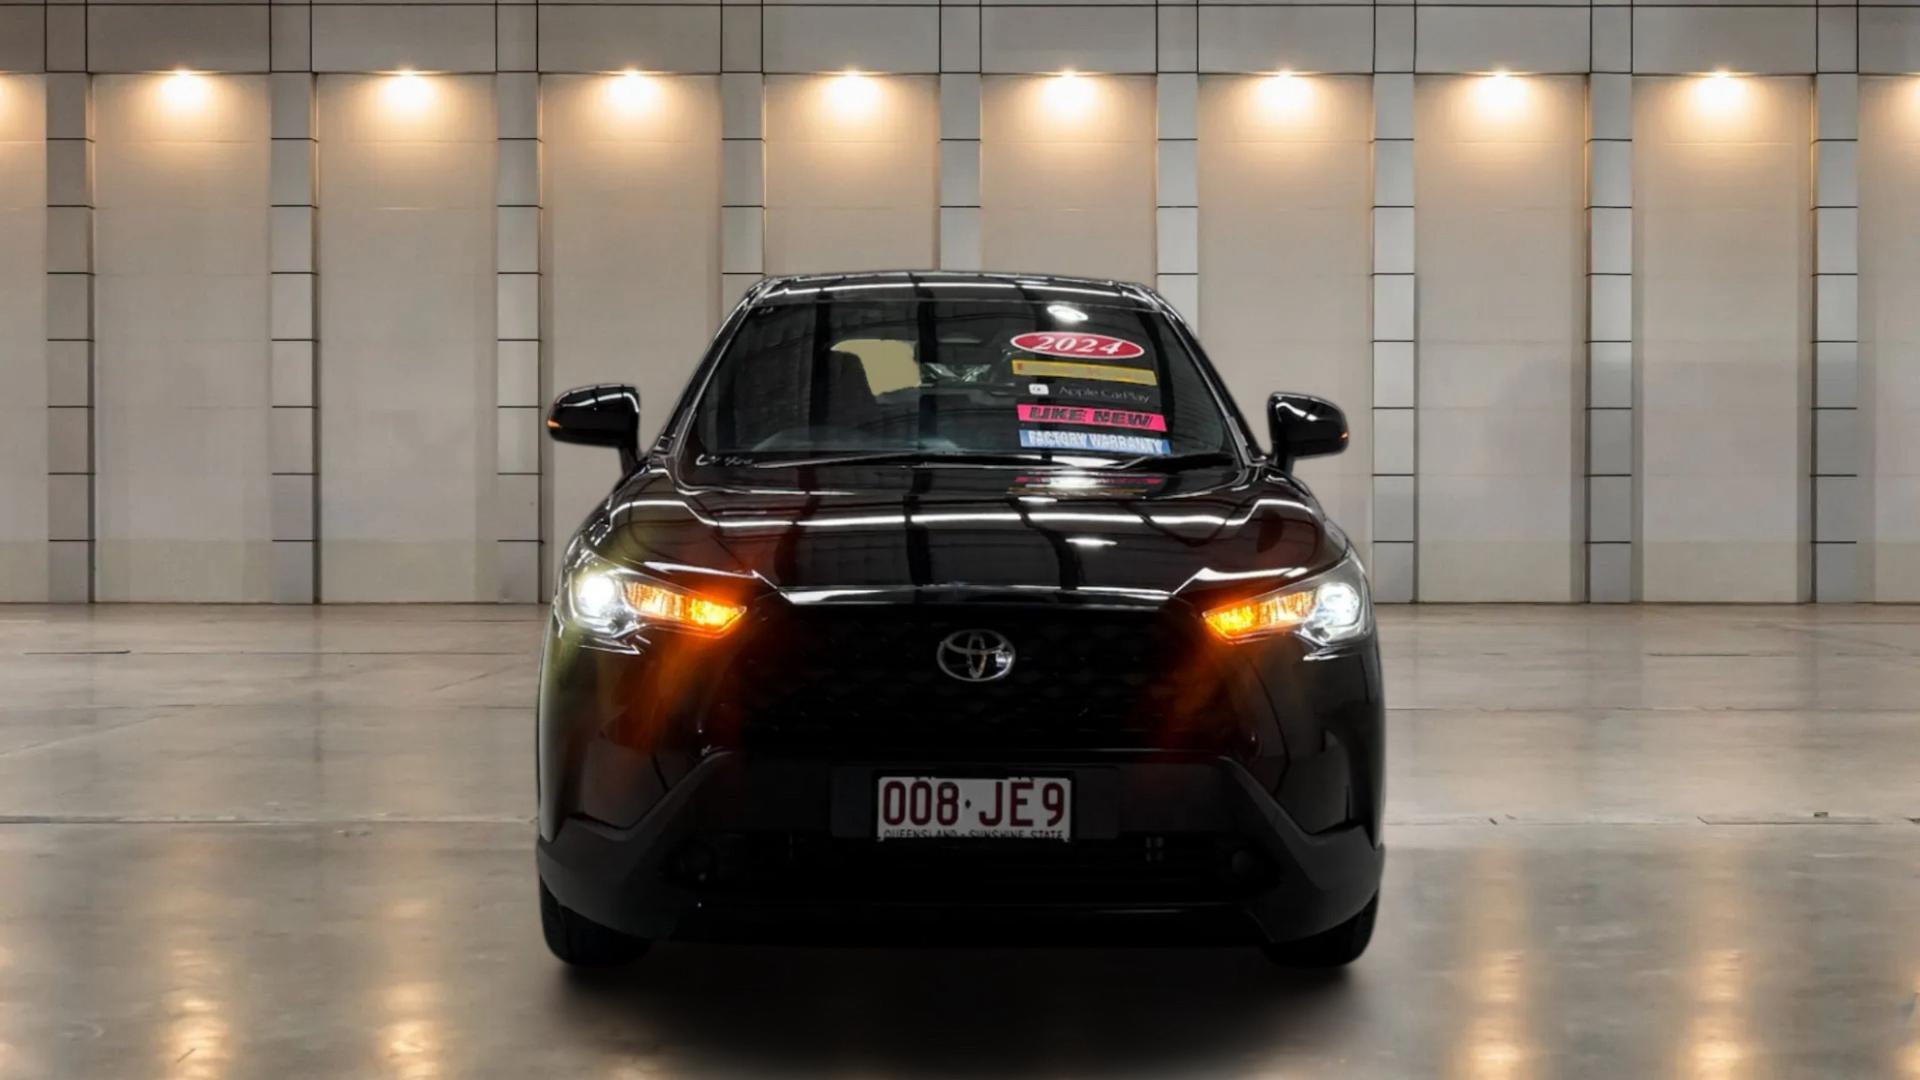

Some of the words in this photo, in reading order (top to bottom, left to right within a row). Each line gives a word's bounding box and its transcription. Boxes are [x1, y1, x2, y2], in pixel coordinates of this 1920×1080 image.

[1034, 335, 1121, 354] 2024
[1058, 385, 1099, 400] Apple
[1029, 406, 1085, 420] LIKE
[1092, 411, 1153, 426] NEW
[1029, 430, 1087, 447] FACTORY
[1088, 435, 1163, 454] WARRANTY
[883, 780, 960, 826] 008
[978, 781, 1065, 828] JE9
[884, 829, 958, 838] QUEENSLAND
[969, 829, 1024, 838] SUNSHINE
[1031, 830, 1064, 839] STATE
